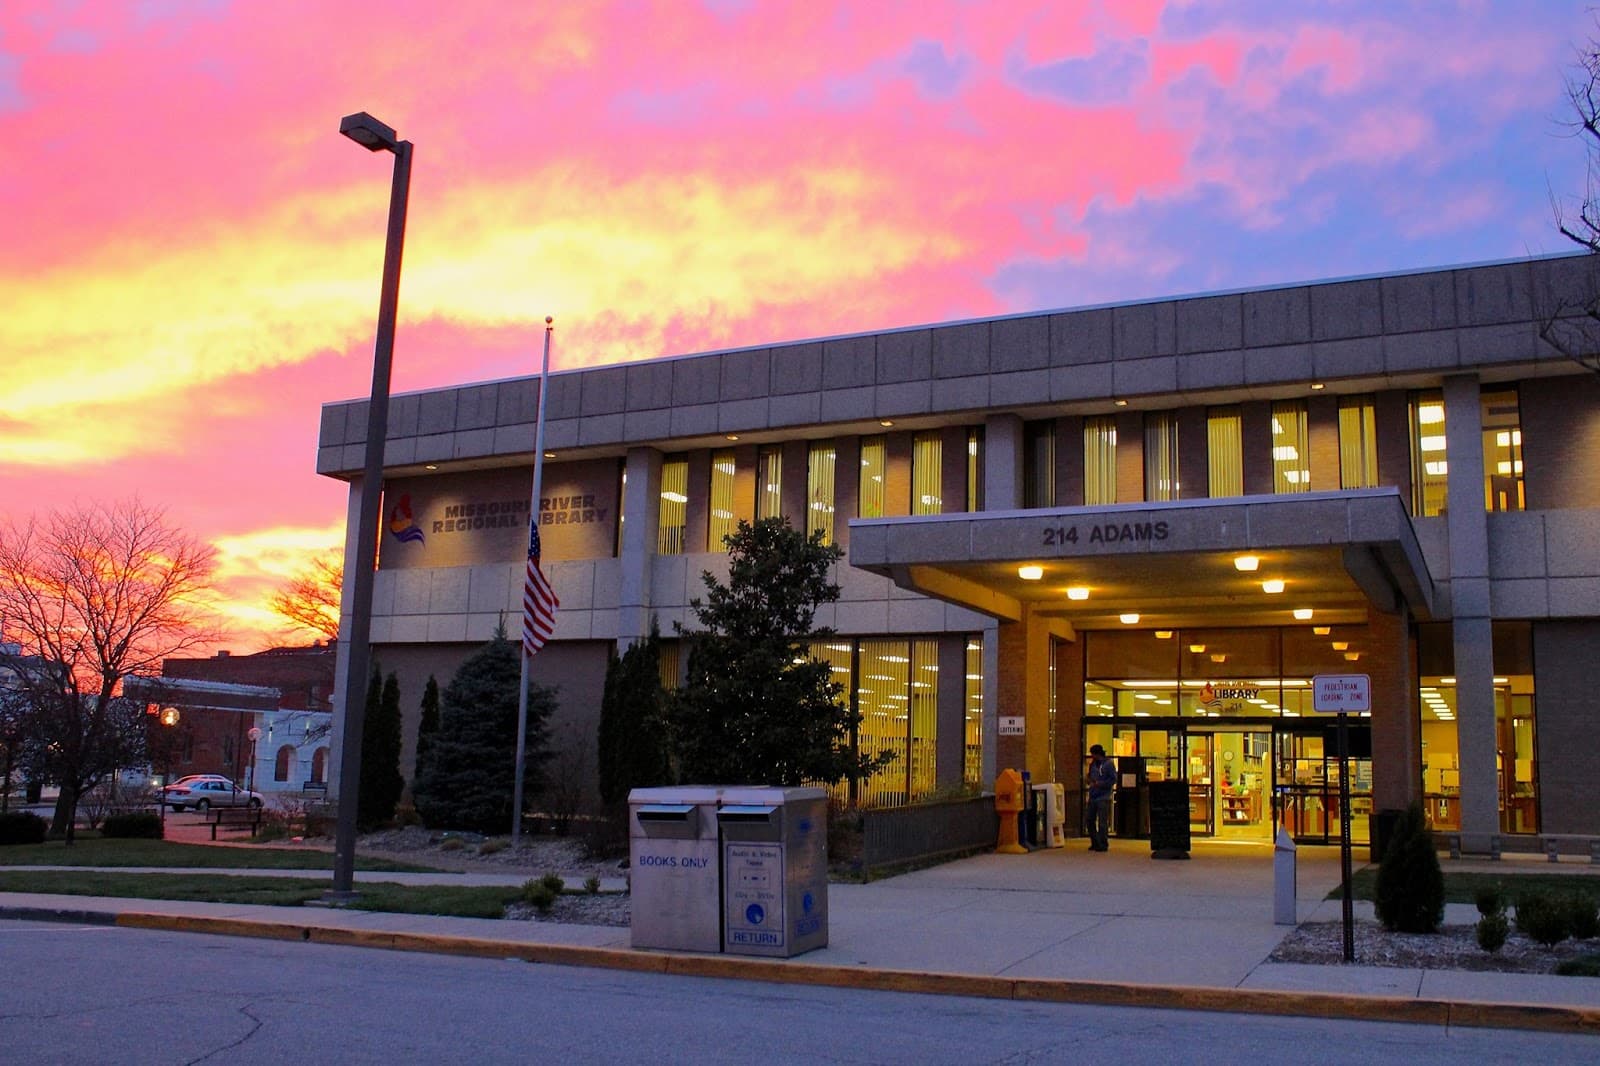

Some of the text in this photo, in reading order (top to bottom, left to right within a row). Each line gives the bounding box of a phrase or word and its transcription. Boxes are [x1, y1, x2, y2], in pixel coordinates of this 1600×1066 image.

[445, 495, 595, 518] MISSOURI RIVER
[432, 514, 518, 533] REGIONAL
[1043, 521, 1170, 545] 214 ADAMS
[1324, 682, 1358, 690] PEDESTRIAN
[1214, 688, 1259, 699] LIBRARY
[1320, 693, 1344, 701] LOADING
[639, 855, 709, 868] BOOKS ONLY
[734, 931, 777, 944] RETURN
